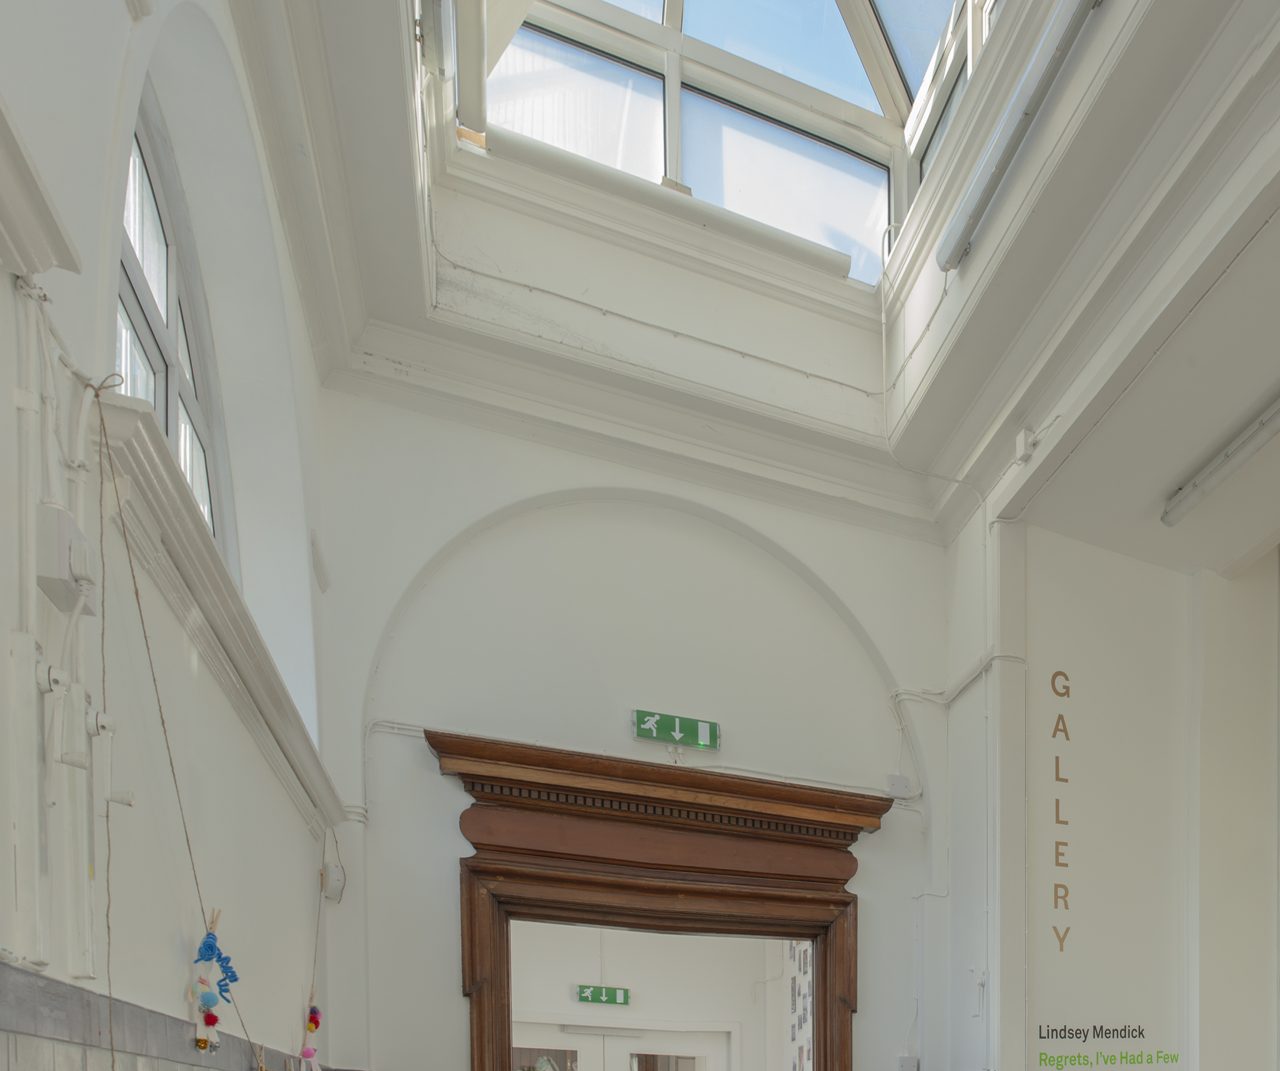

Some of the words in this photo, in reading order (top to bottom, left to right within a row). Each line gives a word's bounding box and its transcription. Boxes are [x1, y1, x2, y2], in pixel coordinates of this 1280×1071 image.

[1050, 670, 1071, 953] GALLERY
[1039, 1025, 1089, 1043] Lindsey
[1092, 1025, 1145, 1039] Mendick
[1039, 1051, 1093, 1071] Regrets,
[1095, 1051, 1117, 1065] I've
[1120, 1050, 1143, 1065] Had
[1146, 1054, 1154, 1064] a
[1156, 1050, 1179, 1064] Few
